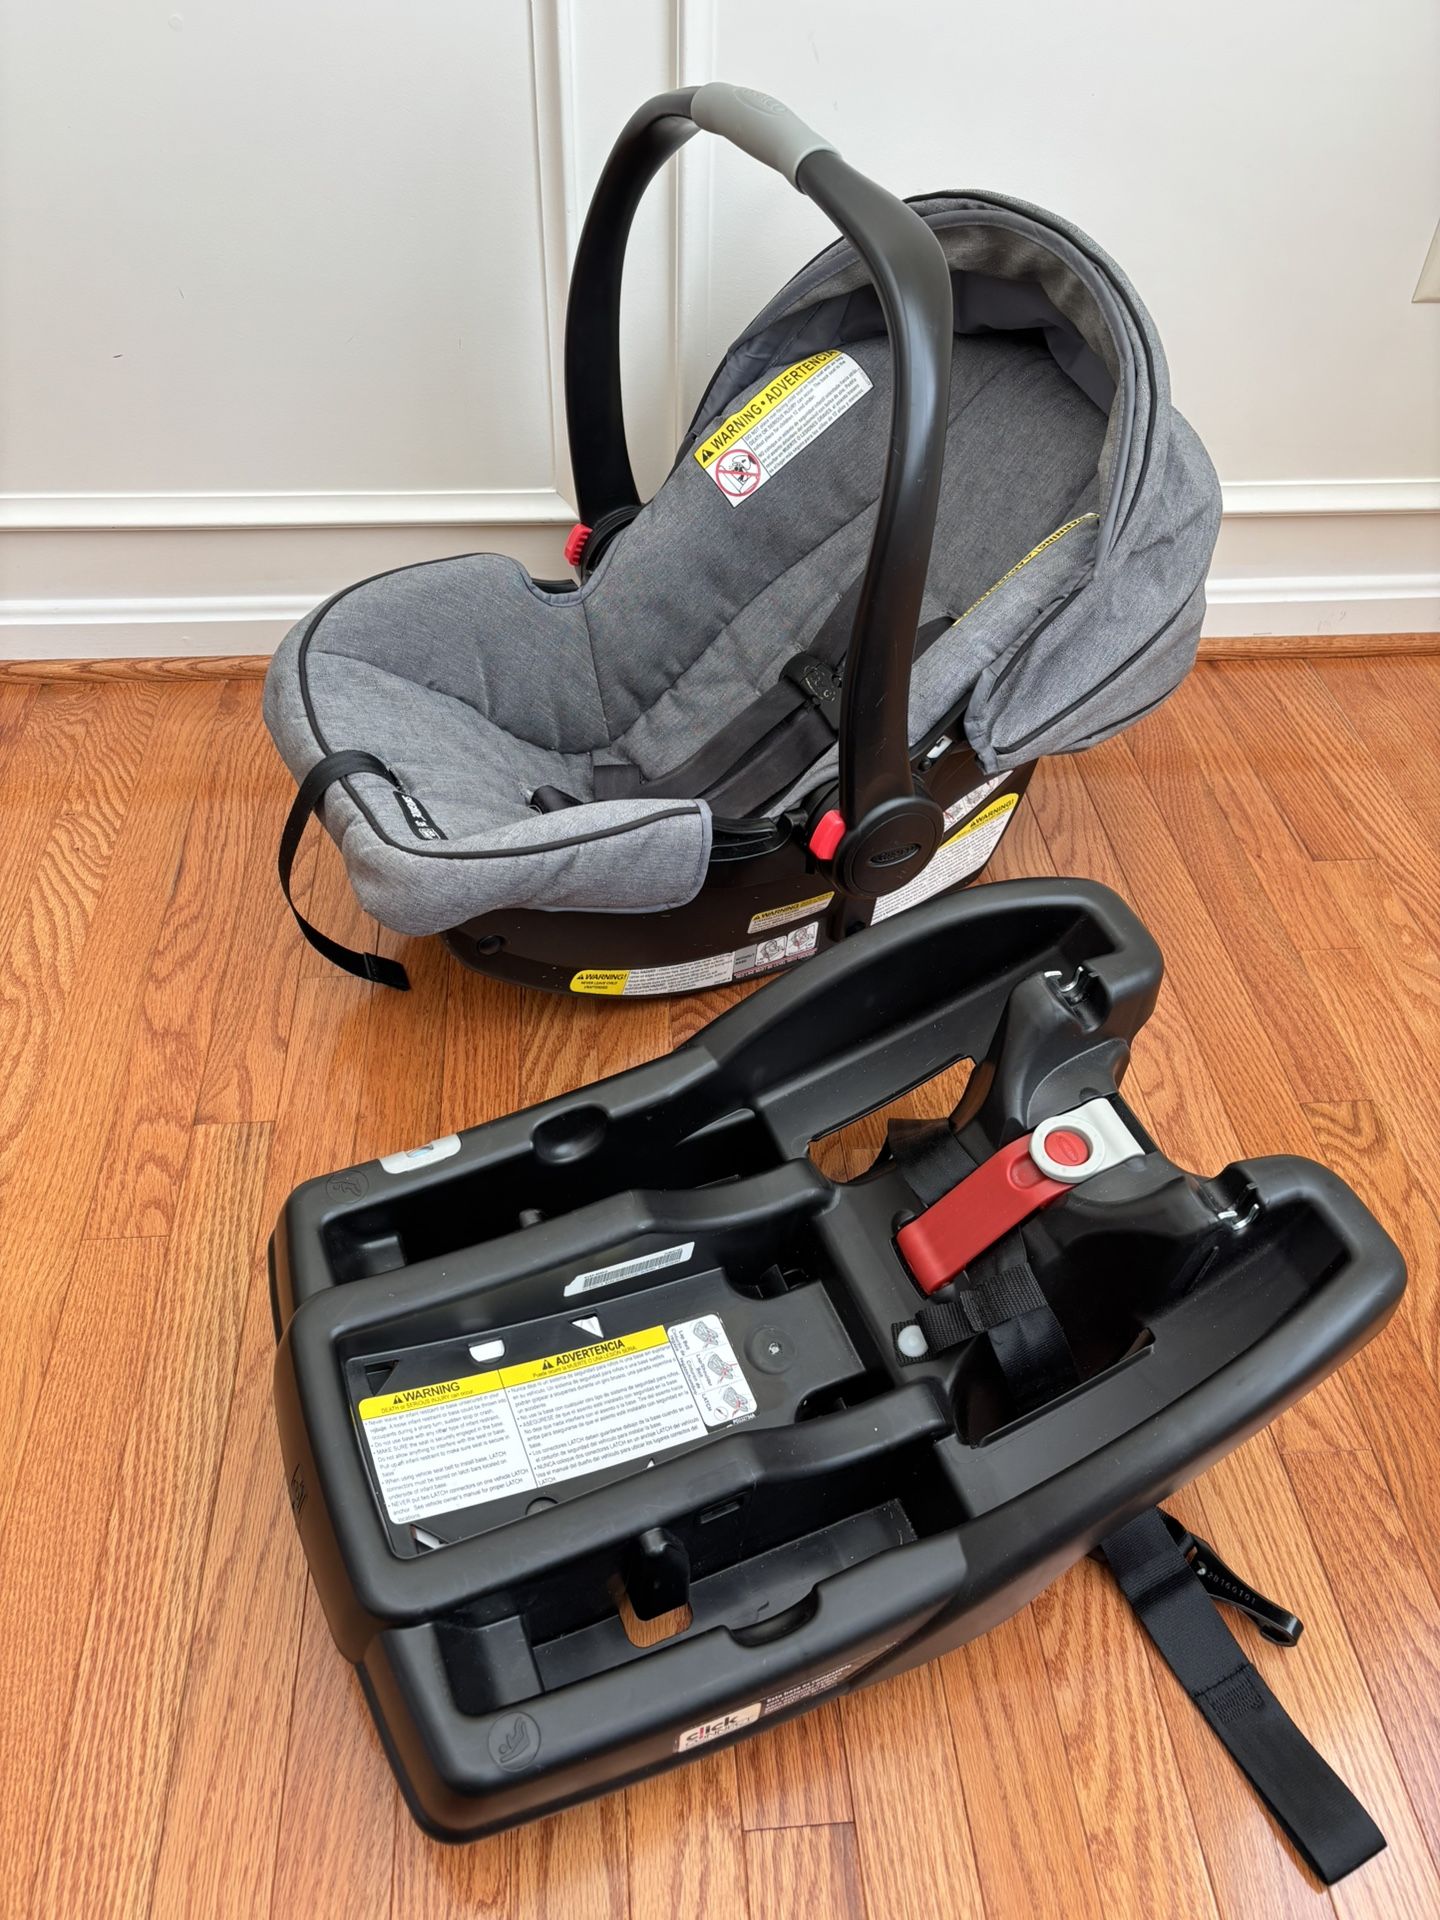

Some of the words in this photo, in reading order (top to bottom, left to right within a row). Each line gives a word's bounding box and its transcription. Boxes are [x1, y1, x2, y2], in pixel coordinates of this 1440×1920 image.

[711, 403, 762, 451] WARNING
[765, 350, 838, 405] ADVERTENCIA
[749, 433, 761, 444] DEATH
[768, 414, 783, 428] SERIOUS
[784, 402, 796, 414] INJURY
[975, 798, 1015, 823] WARNING!
[554, 1338, 625, 1366] ADVERTENCIA
[566, 1359, 587, 1368] MUERTE
[402, 1381, 460, 1402] WARNING
[701, 1393, 712, 1411] LATCH
[380, 1405, 399, 1414] DEATH
[406, 1398, 430, 1408] SERIOUS
[430, 1394, 449, 1402] INJURY
[566, 1436, 584, 1445] LATCH
[608, 1438, 626, 1448] LATCH
[655, 1424, 672, 1433] LATCH
[488, 1450, 506, 1459] LATCH
[391, 1499, 411, 1508] NEVER
[429, 1489, 448, 1498] LATCH
[510, 1468, 528, 1477] LATCH
[505, 1477, 523, 1486] LATCH
[686, 1716, 738, 1742] click
